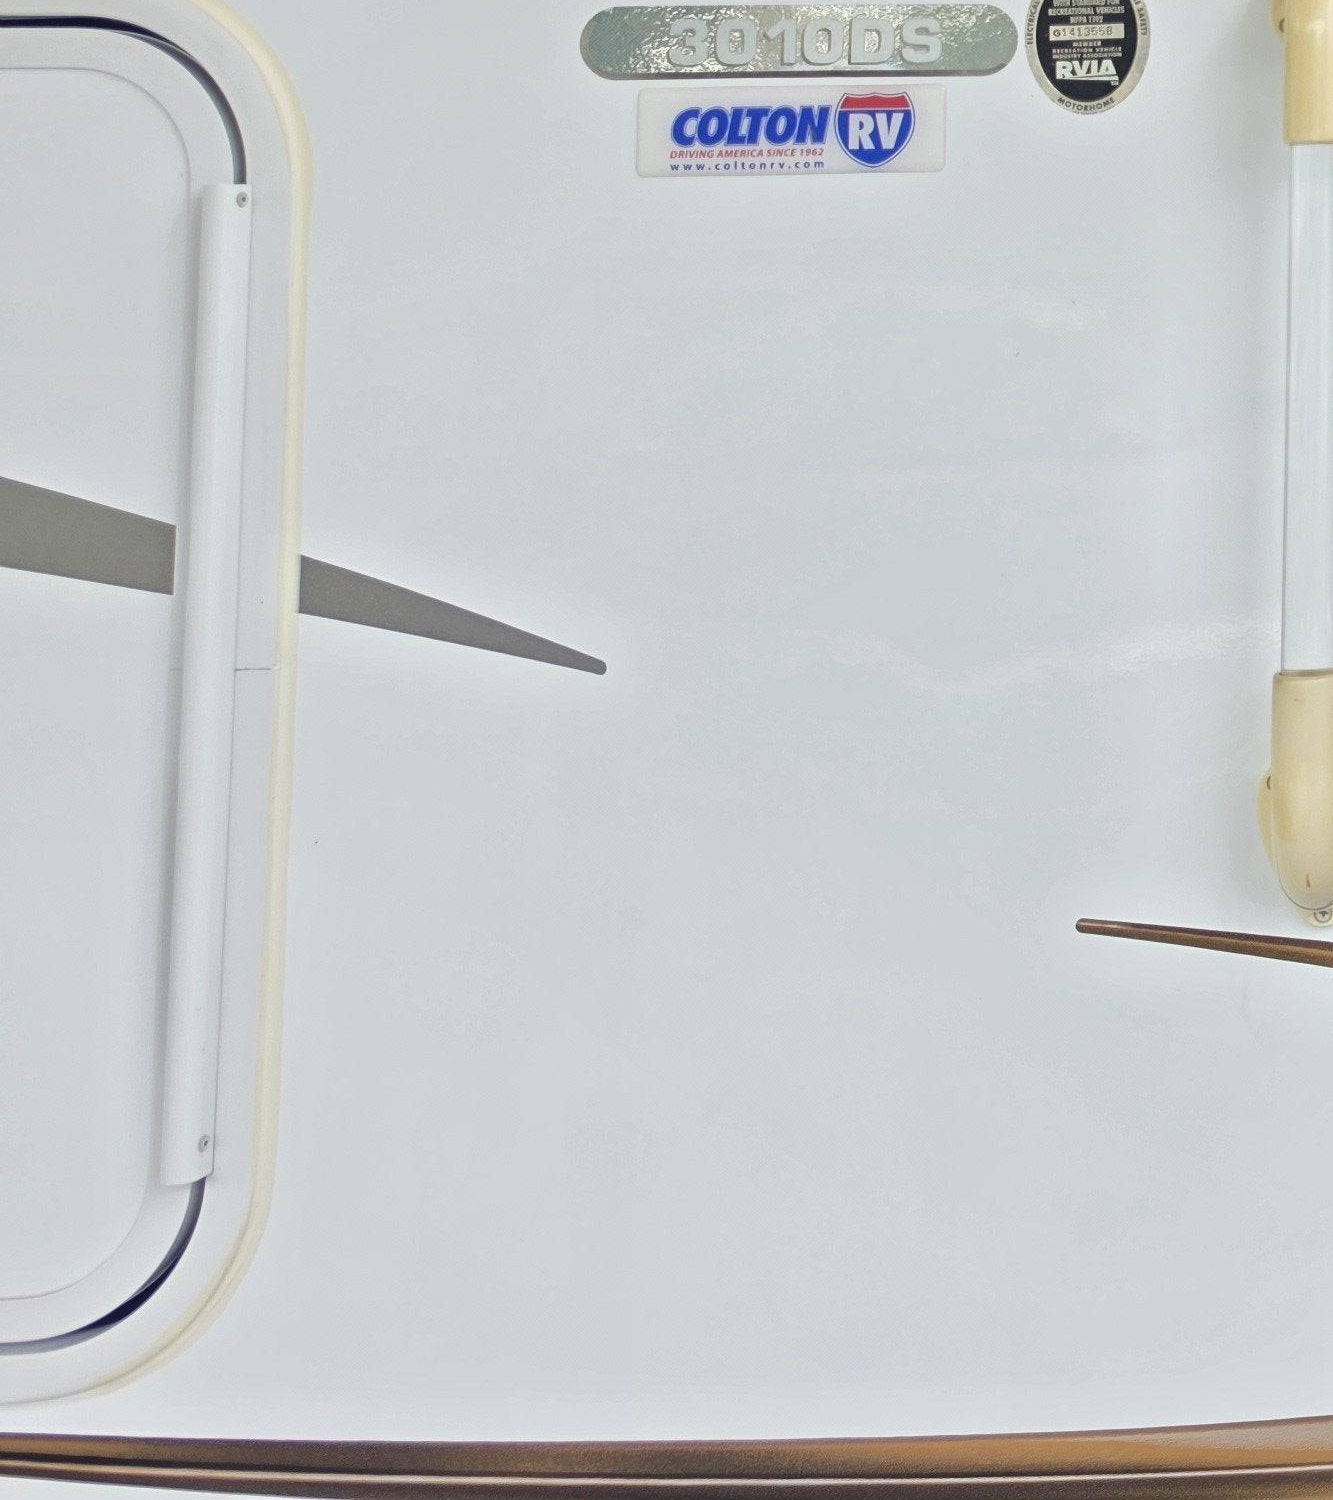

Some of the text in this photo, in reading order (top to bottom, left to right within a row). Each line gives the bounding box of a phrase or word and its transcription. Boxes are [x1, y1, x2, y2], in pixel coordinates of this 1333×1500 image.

[1049, 8, 1094, 16] RECREATIONAL
[1056, 61, 1117, 79] RVIA
[1058, 98, 1115, 112] MOTORHOME
[671, 106, 904, 150] COLTON RV
[671, 148, 824, 159] DRIVING AMERICA SINCE 1962
[671, 161, 825, 171] www.coltonrv.com
